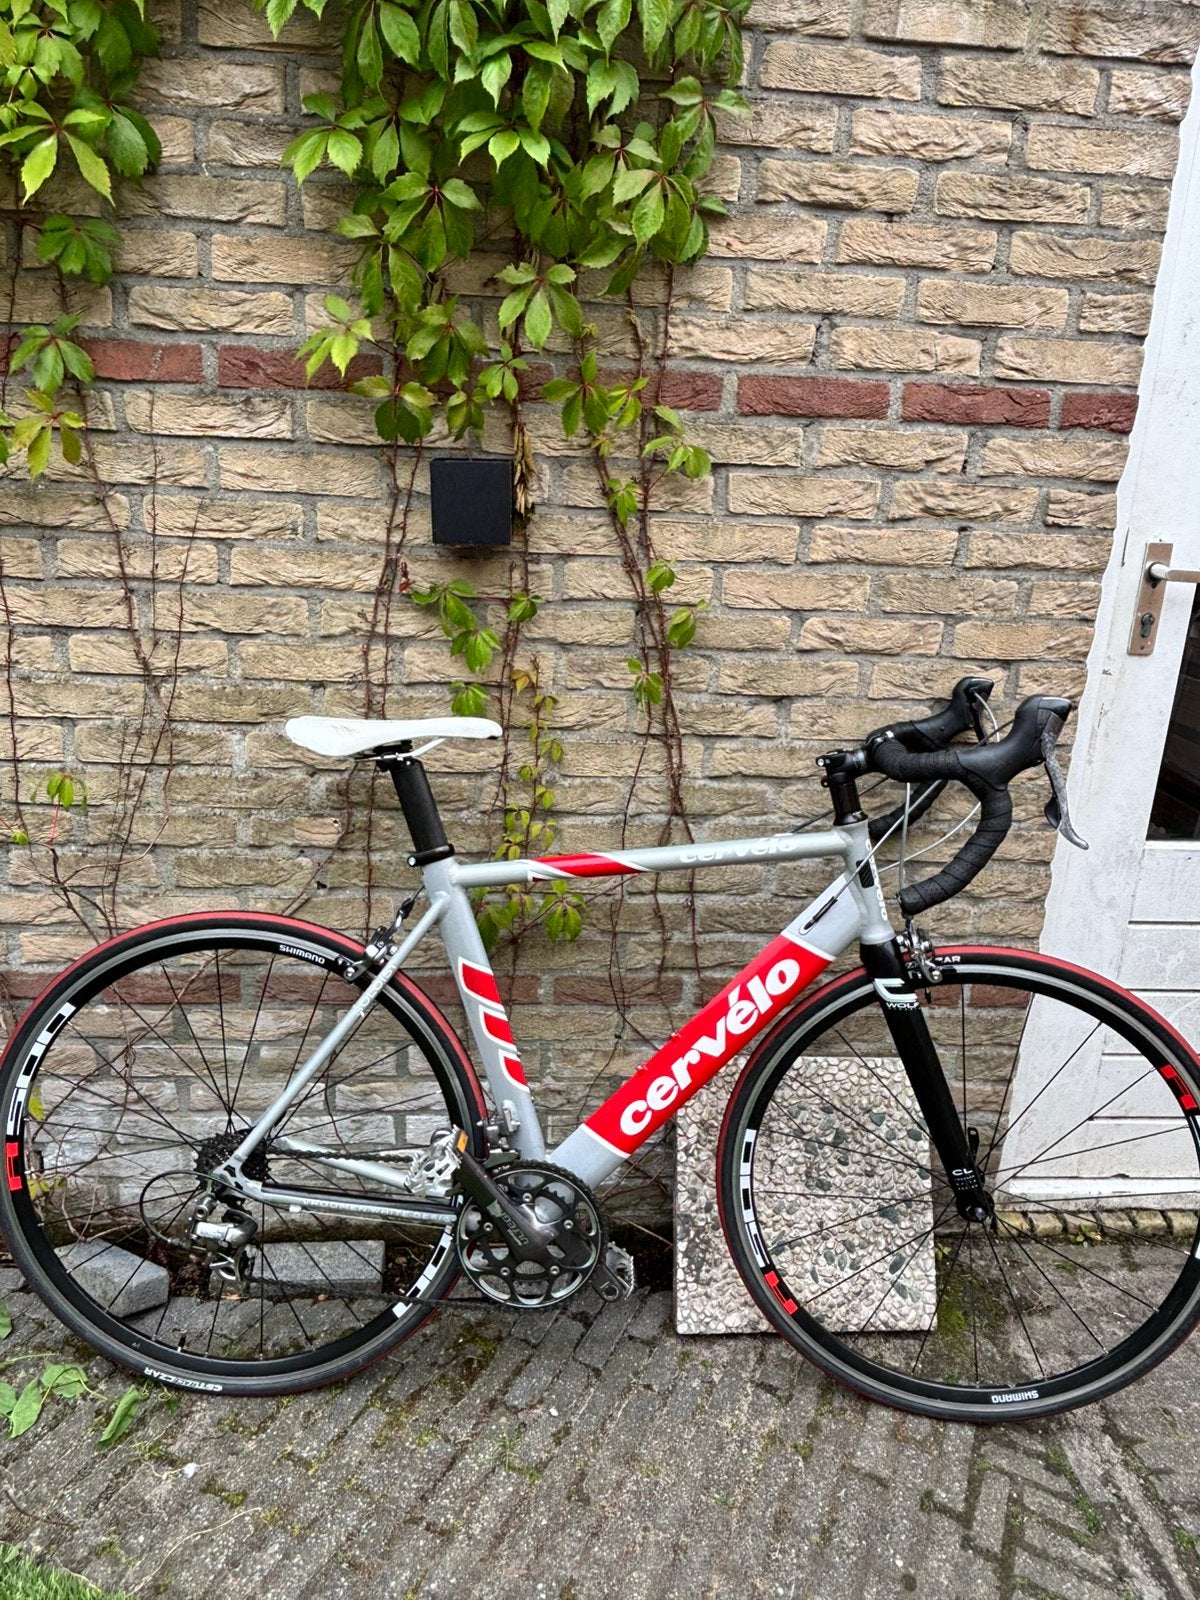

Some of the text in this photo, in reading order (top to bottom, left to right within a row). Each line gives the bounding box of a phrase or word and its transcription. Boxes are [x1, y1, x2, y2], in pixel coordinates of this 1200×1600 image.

[279, 944, 326, 965] SHIMANO
[619, 958, 800, 1136] cervélo
[501, 1210, 529, 1245] ULTEG
[991, 1390, 1039, 1404] SHIMANO
